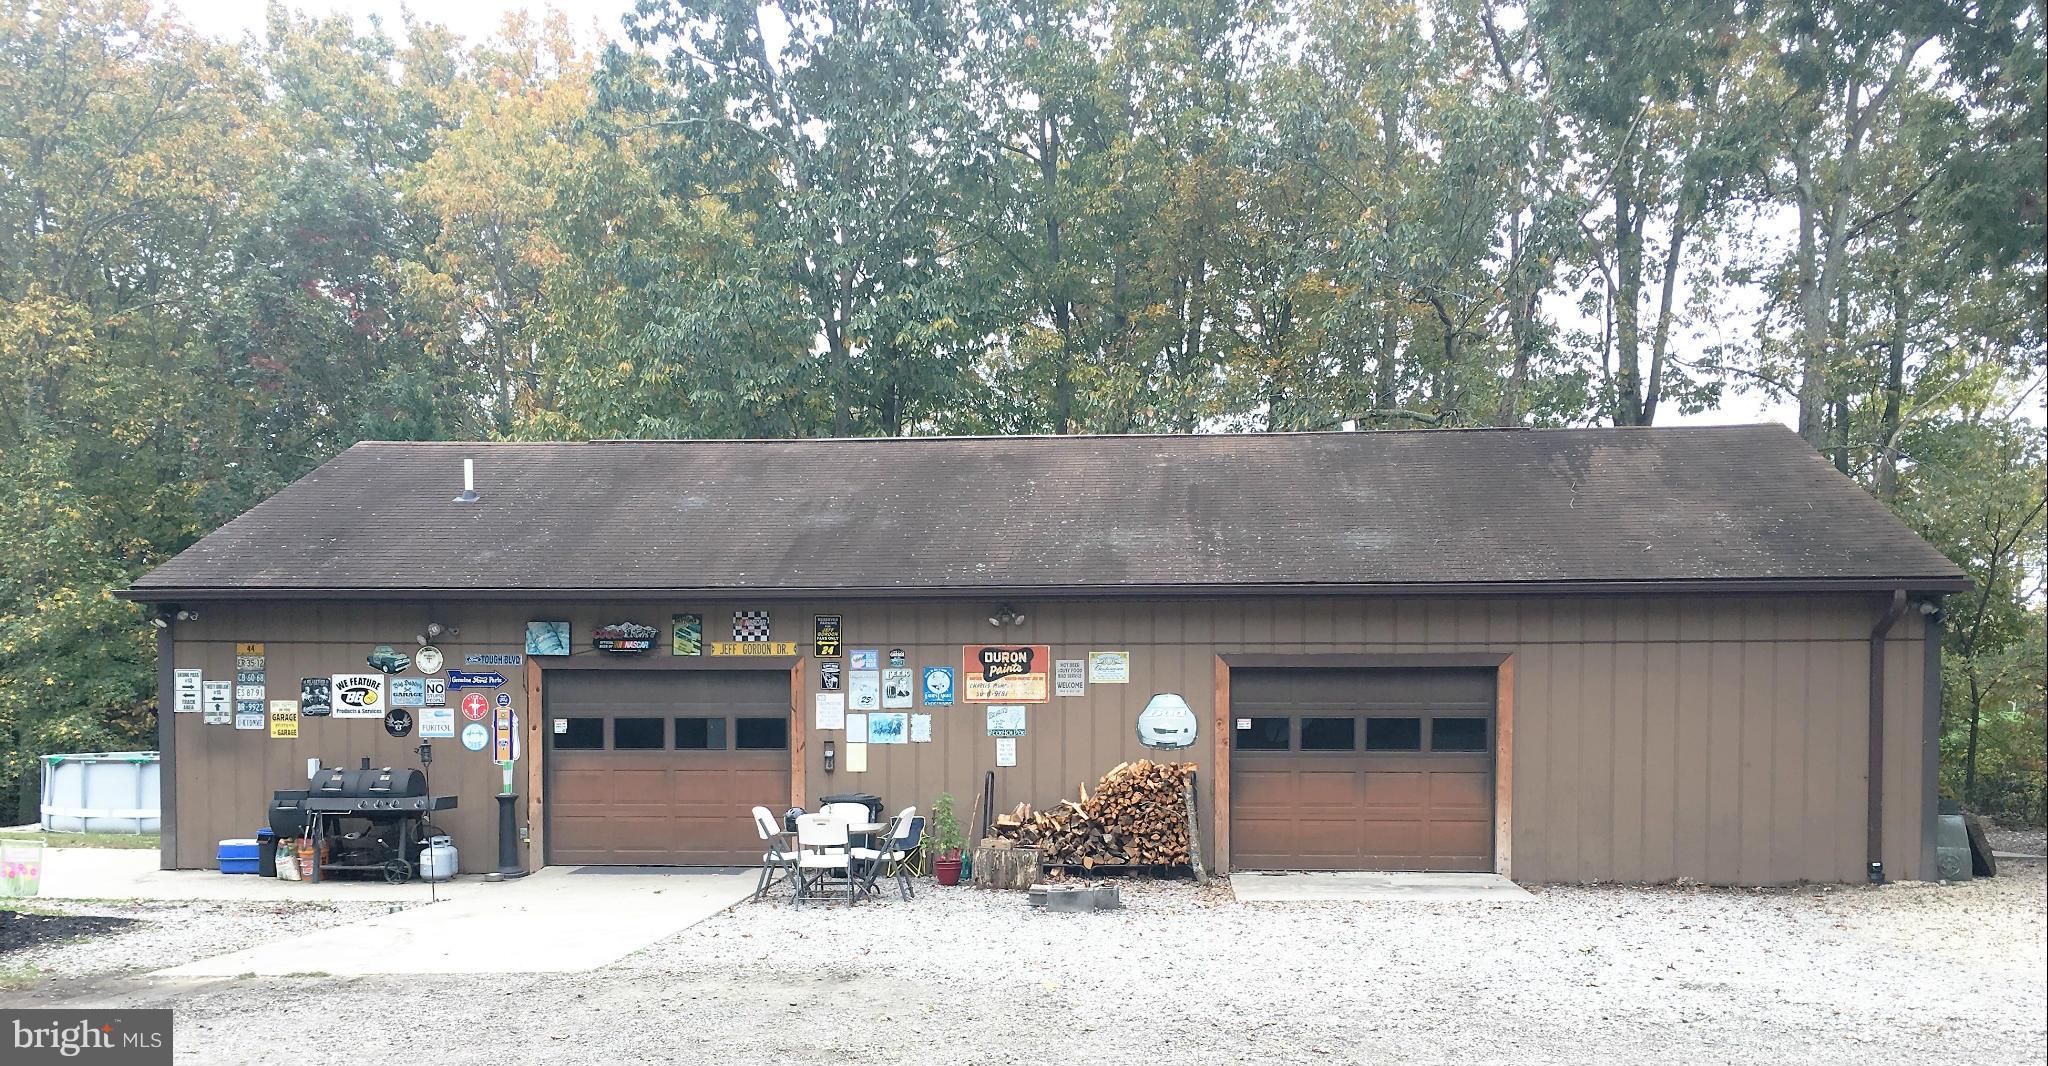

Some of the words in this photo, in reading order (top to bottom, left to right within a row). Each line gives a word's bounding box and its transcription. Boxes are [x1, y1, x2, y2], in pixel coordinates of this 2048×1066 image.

[720, 644, 736, 655] JEFF
[742, 644, 772, 655] GORDON
[777, 644, 788, 654] DR.
[821, 646, 834, 654] 24
[481, 655, 502, 664] TOUGH
[504, 655, 520, 664] BLVD
[984, 652, 1027, 662] DURON
[336, 680, 348, 690] WE
[350, 677, 381, 690] FEATURE
[427, 684, 444, 694] NO
[346, 691, 365, 703] BG
